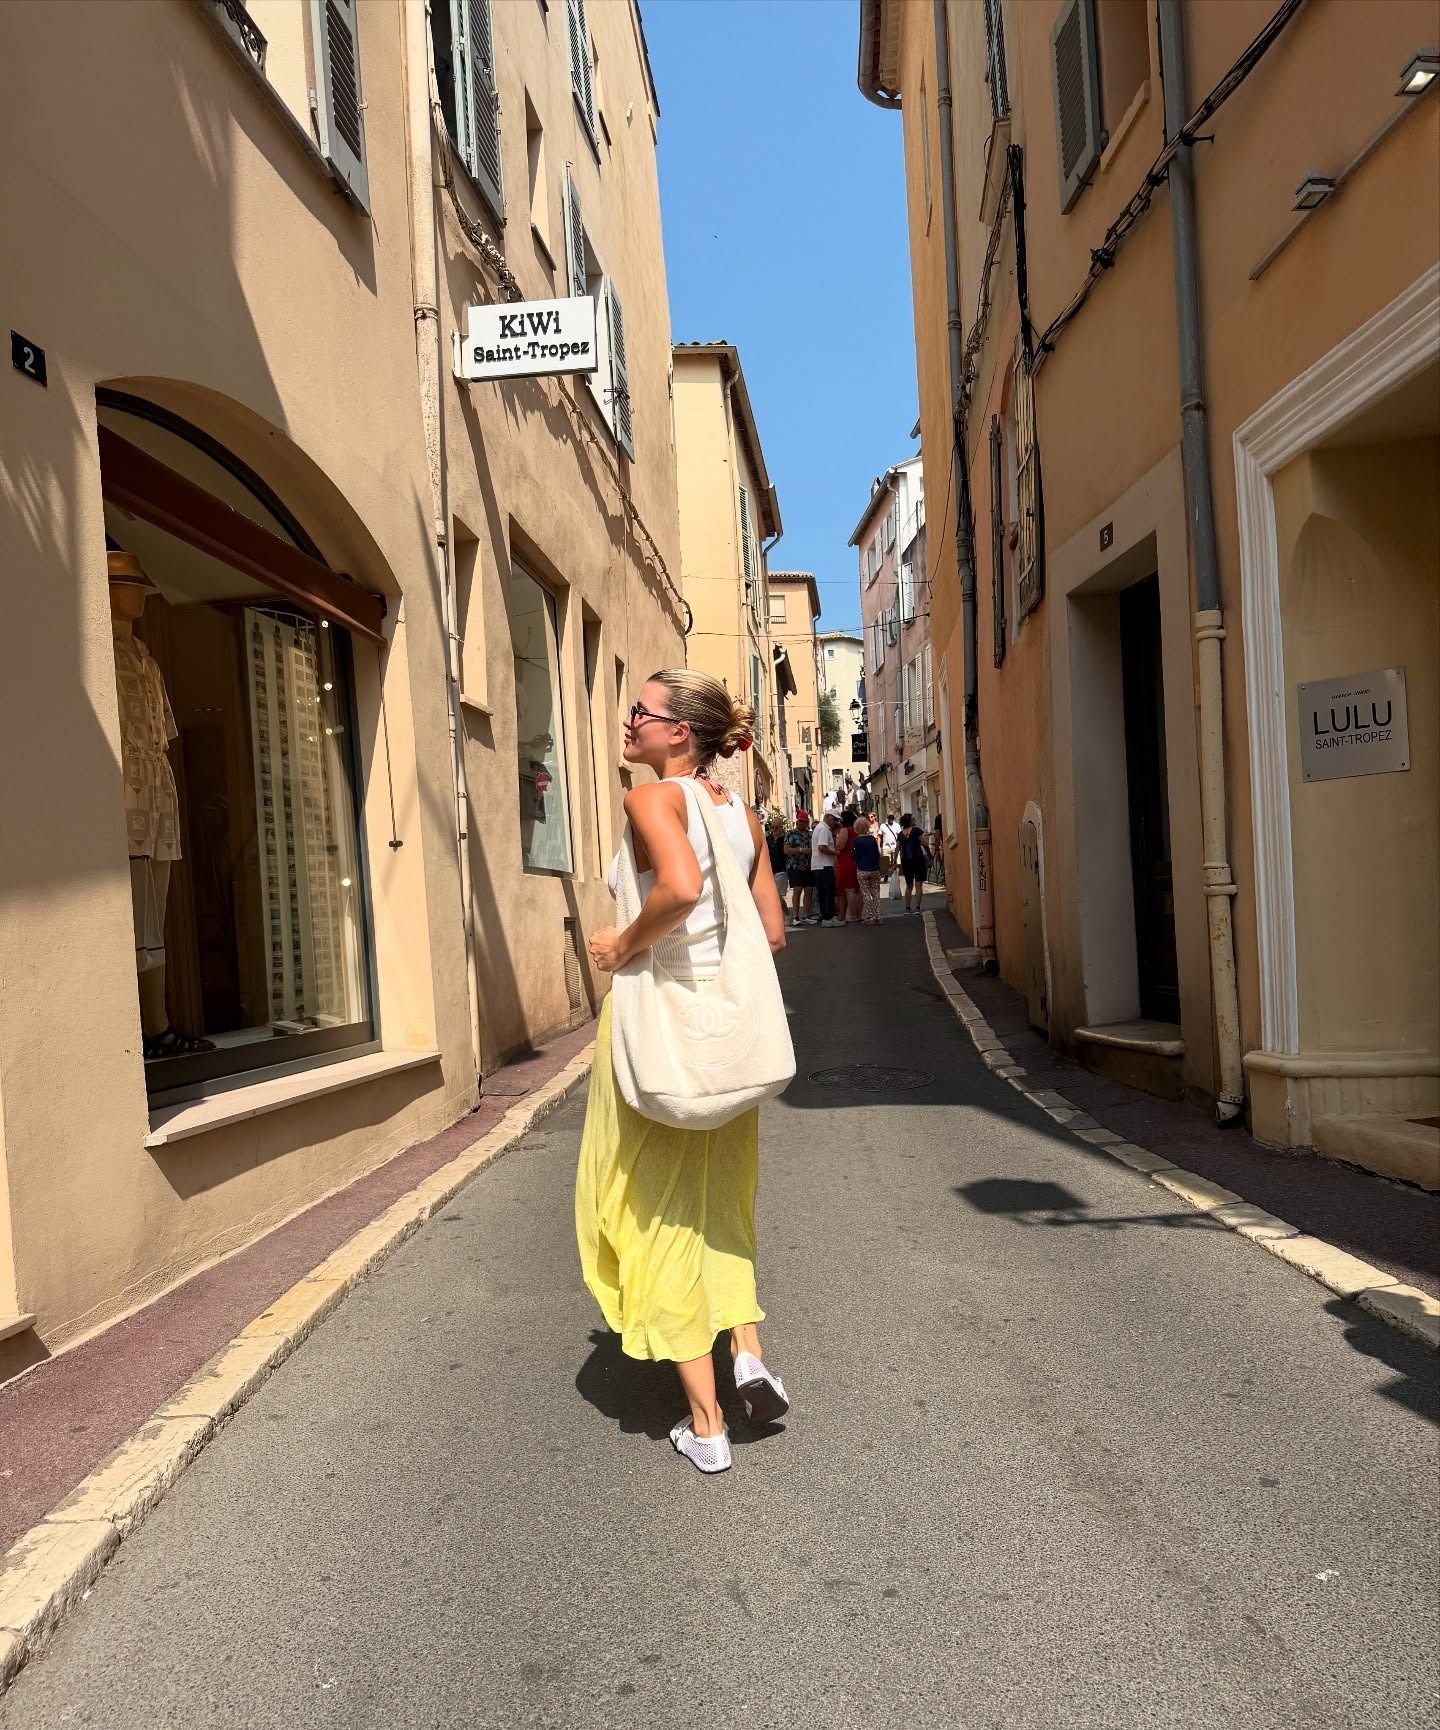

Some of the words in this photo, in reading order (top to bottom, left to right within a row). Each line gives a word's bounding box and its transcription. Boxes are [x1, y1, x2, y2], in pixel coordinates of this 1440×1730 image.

[499, 310, 562, 339] KiWi
[23, 346, 36, 374] 2
[473, 341, 590, 363] Saint-Tropez
[1103, 529, 1109, 545] 5
[1313, 700, 1392, 735] LULU
[1315, 729, 1393, 750] SAINT-TROPEZ
